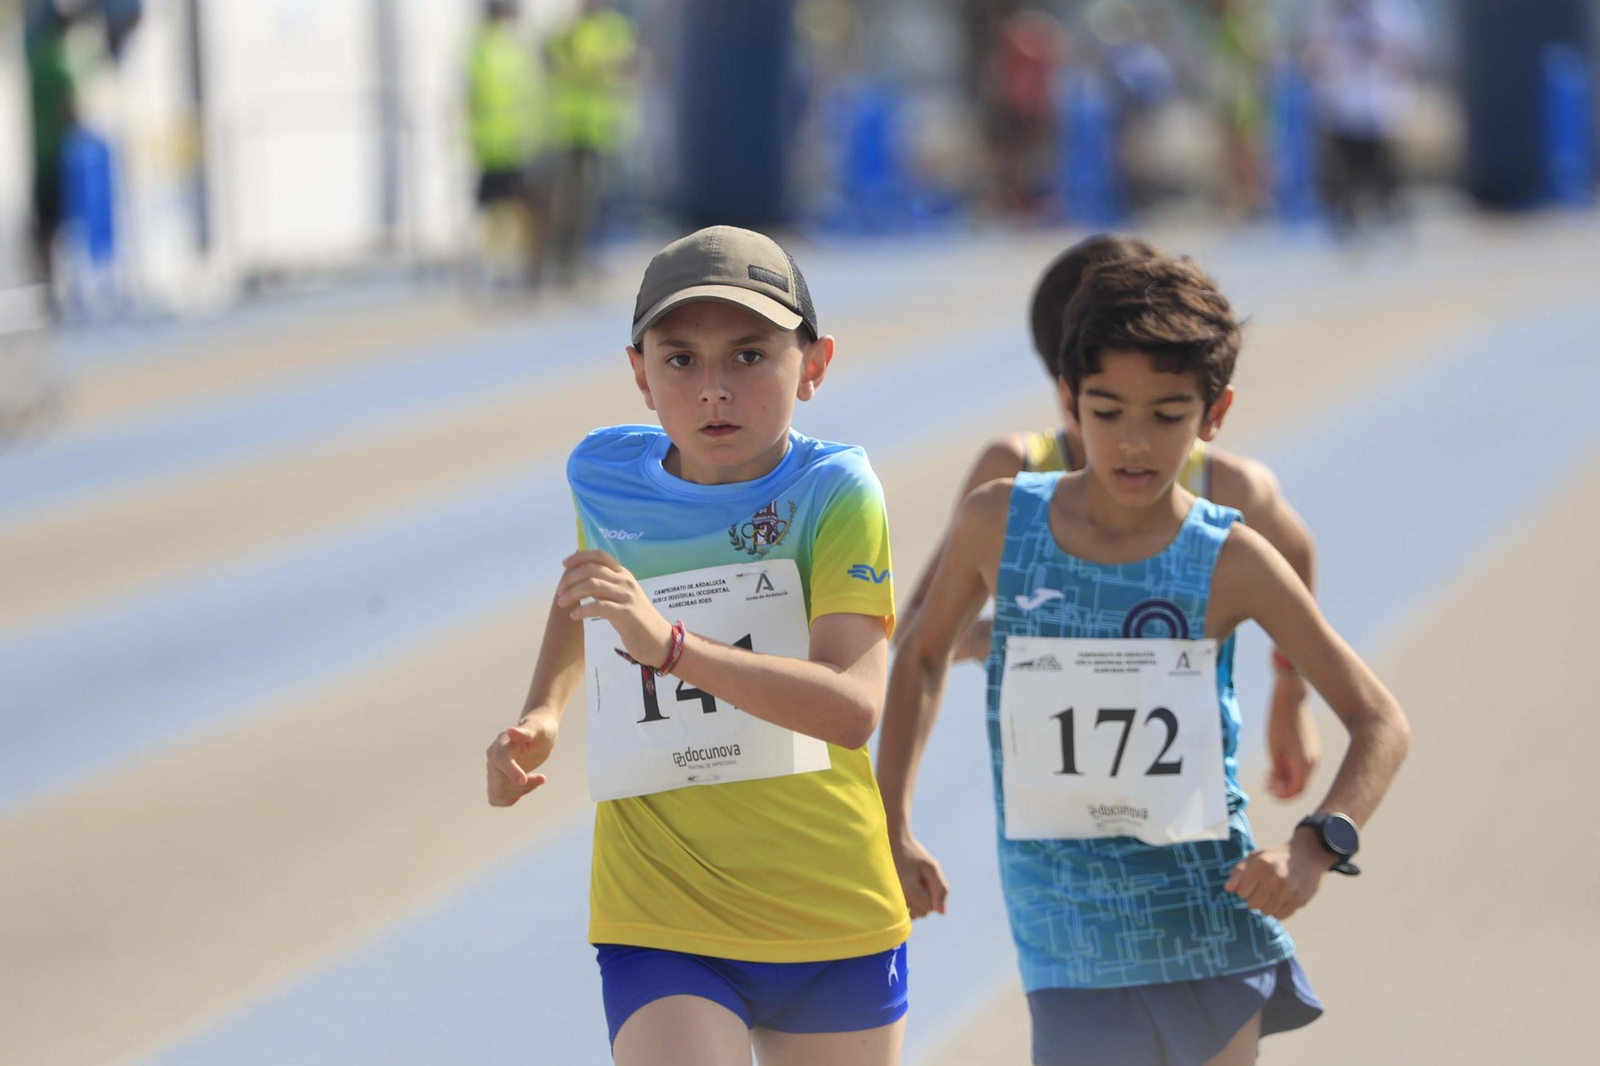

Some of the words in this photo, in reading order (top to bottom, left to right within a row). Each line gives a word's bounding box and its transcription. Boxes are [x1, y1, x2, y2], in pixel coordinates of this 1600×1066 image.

[847, 564, 894, 584] EV
[654, 584, 686, 596] CAMPEONATO
[696, 587, 730, 597] OCCIDENTAL
[1049, 706, 1184, 778] 172
[685, 744, 741, 762] docunova
